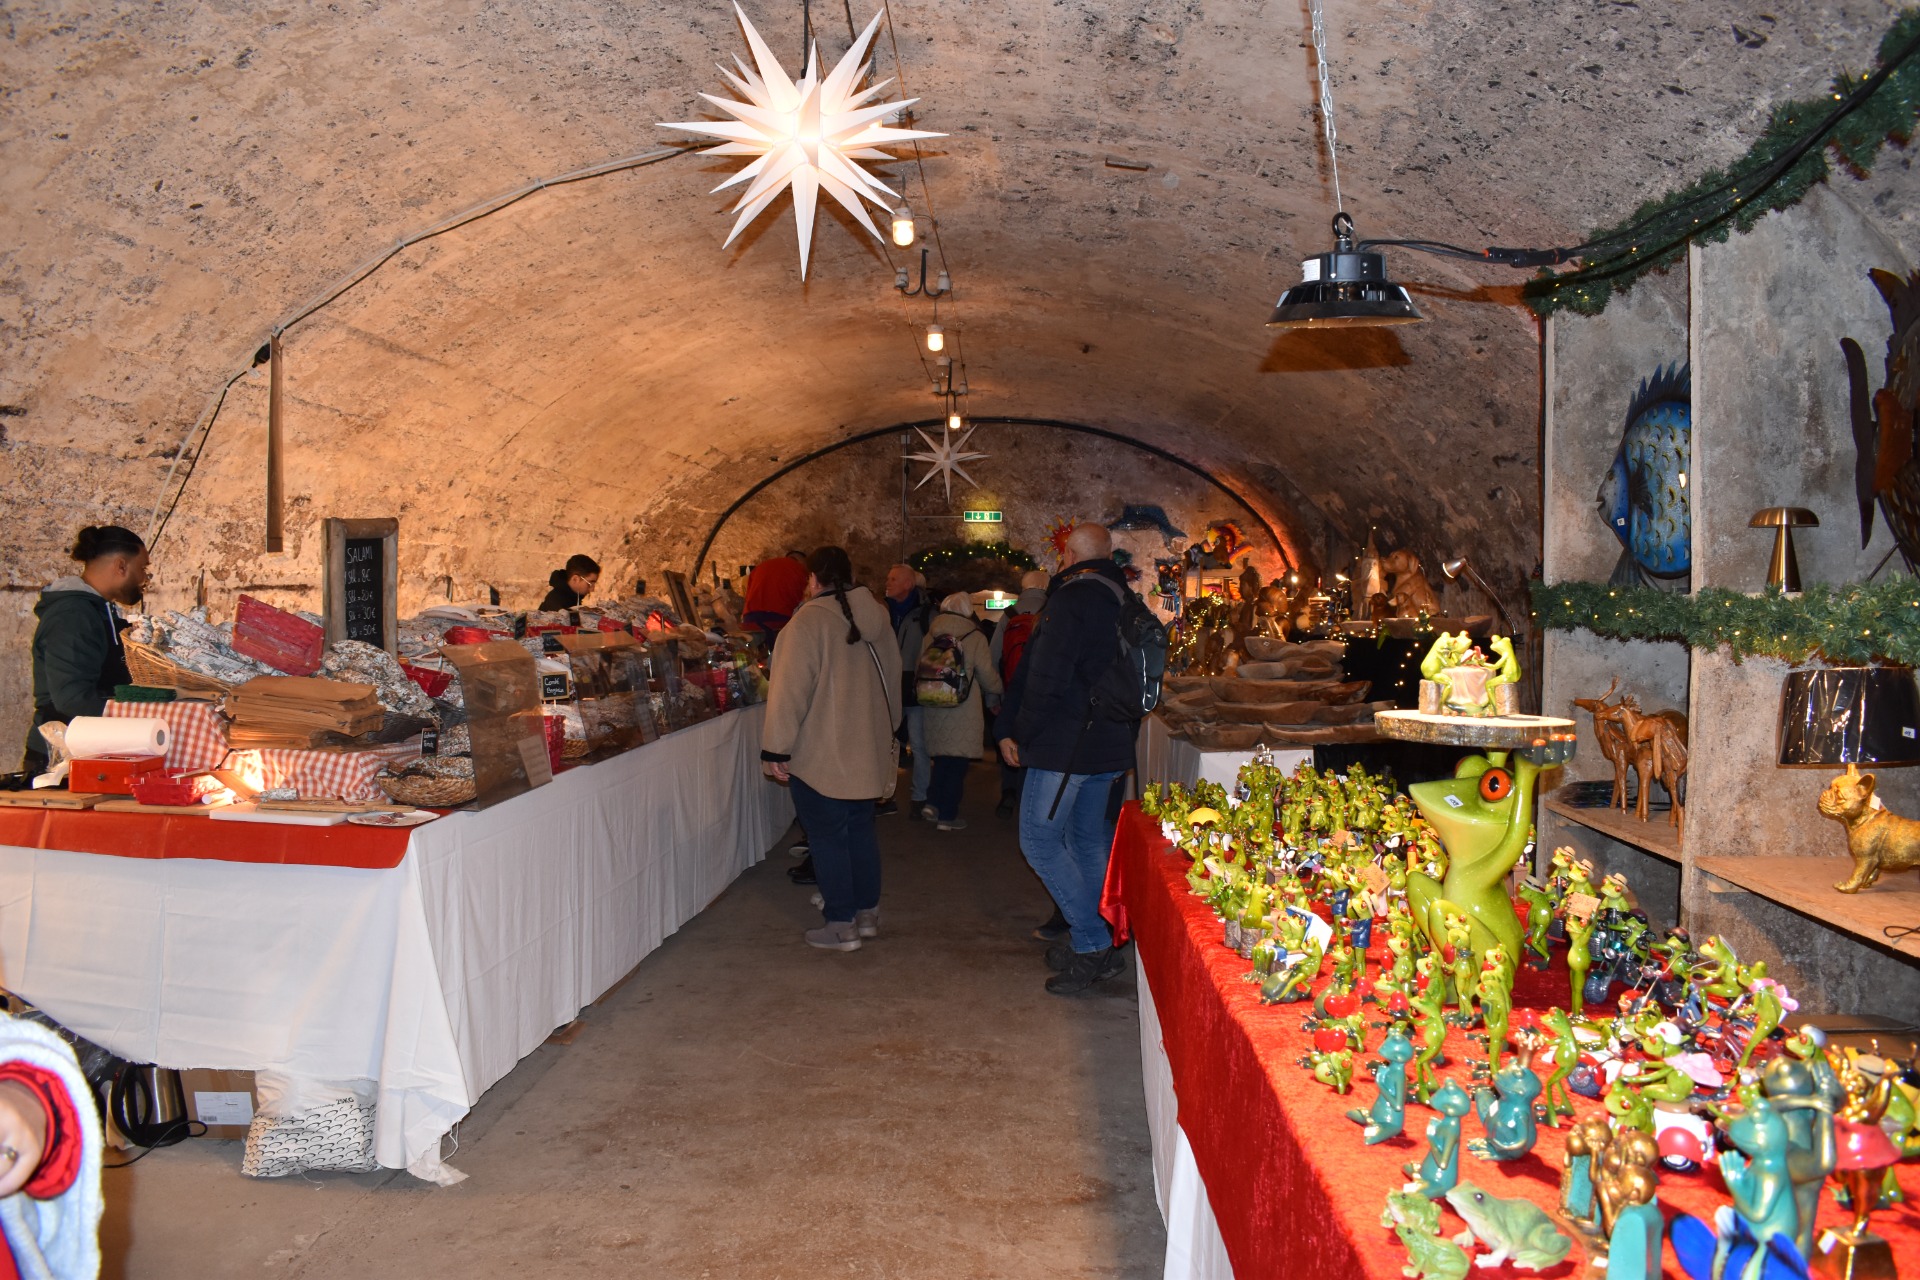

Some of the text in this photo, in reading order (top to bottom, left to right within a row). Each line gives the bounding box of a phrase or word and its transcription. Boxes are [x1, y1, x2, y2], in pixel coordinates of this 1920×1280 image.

[347, 546, 373, 564] SALAMI
[362, 606, 376, 620] 30€
[363, 623, 377, 636] 50€
[335, 1096, 354, 1105] 25KG
